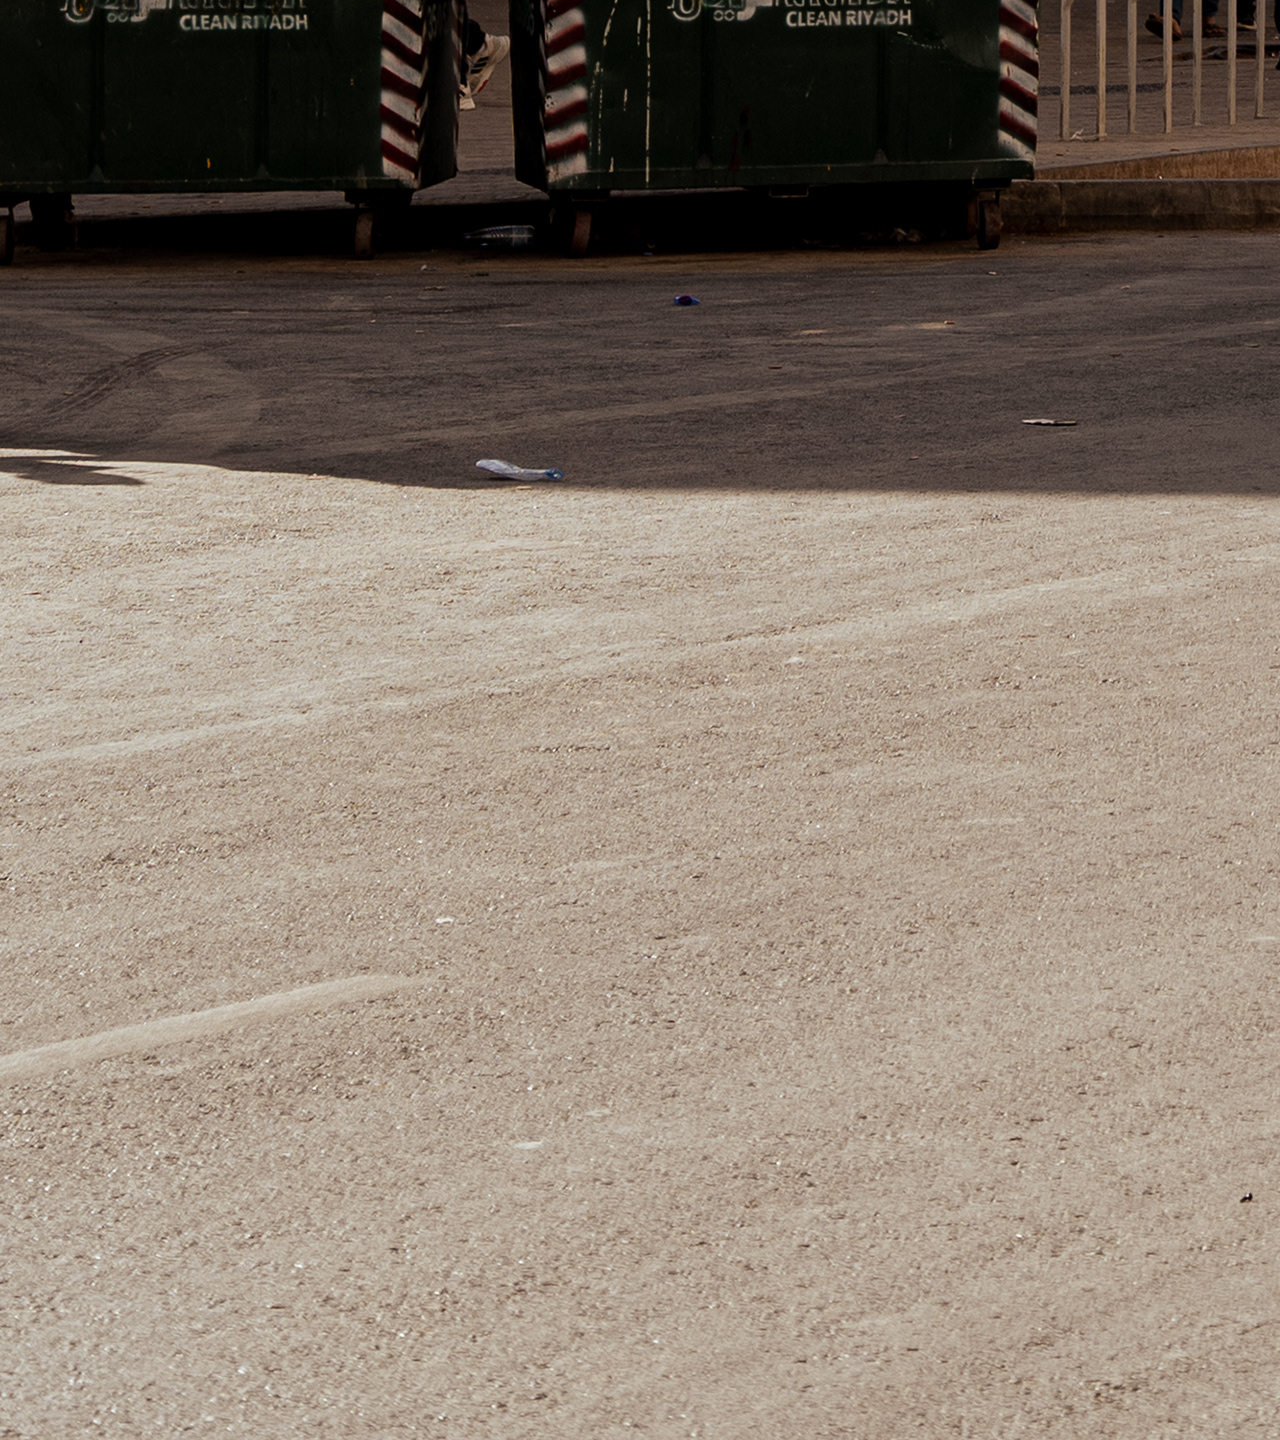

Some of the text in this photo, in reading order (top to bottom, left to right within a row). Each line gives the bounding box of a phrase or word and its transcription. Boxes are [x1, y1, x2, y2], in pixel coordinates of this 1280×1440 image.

[178, 14, 309, 32] CLEAN RIYADH
[784, 9, 914, 28] CLEAN RIYADH
